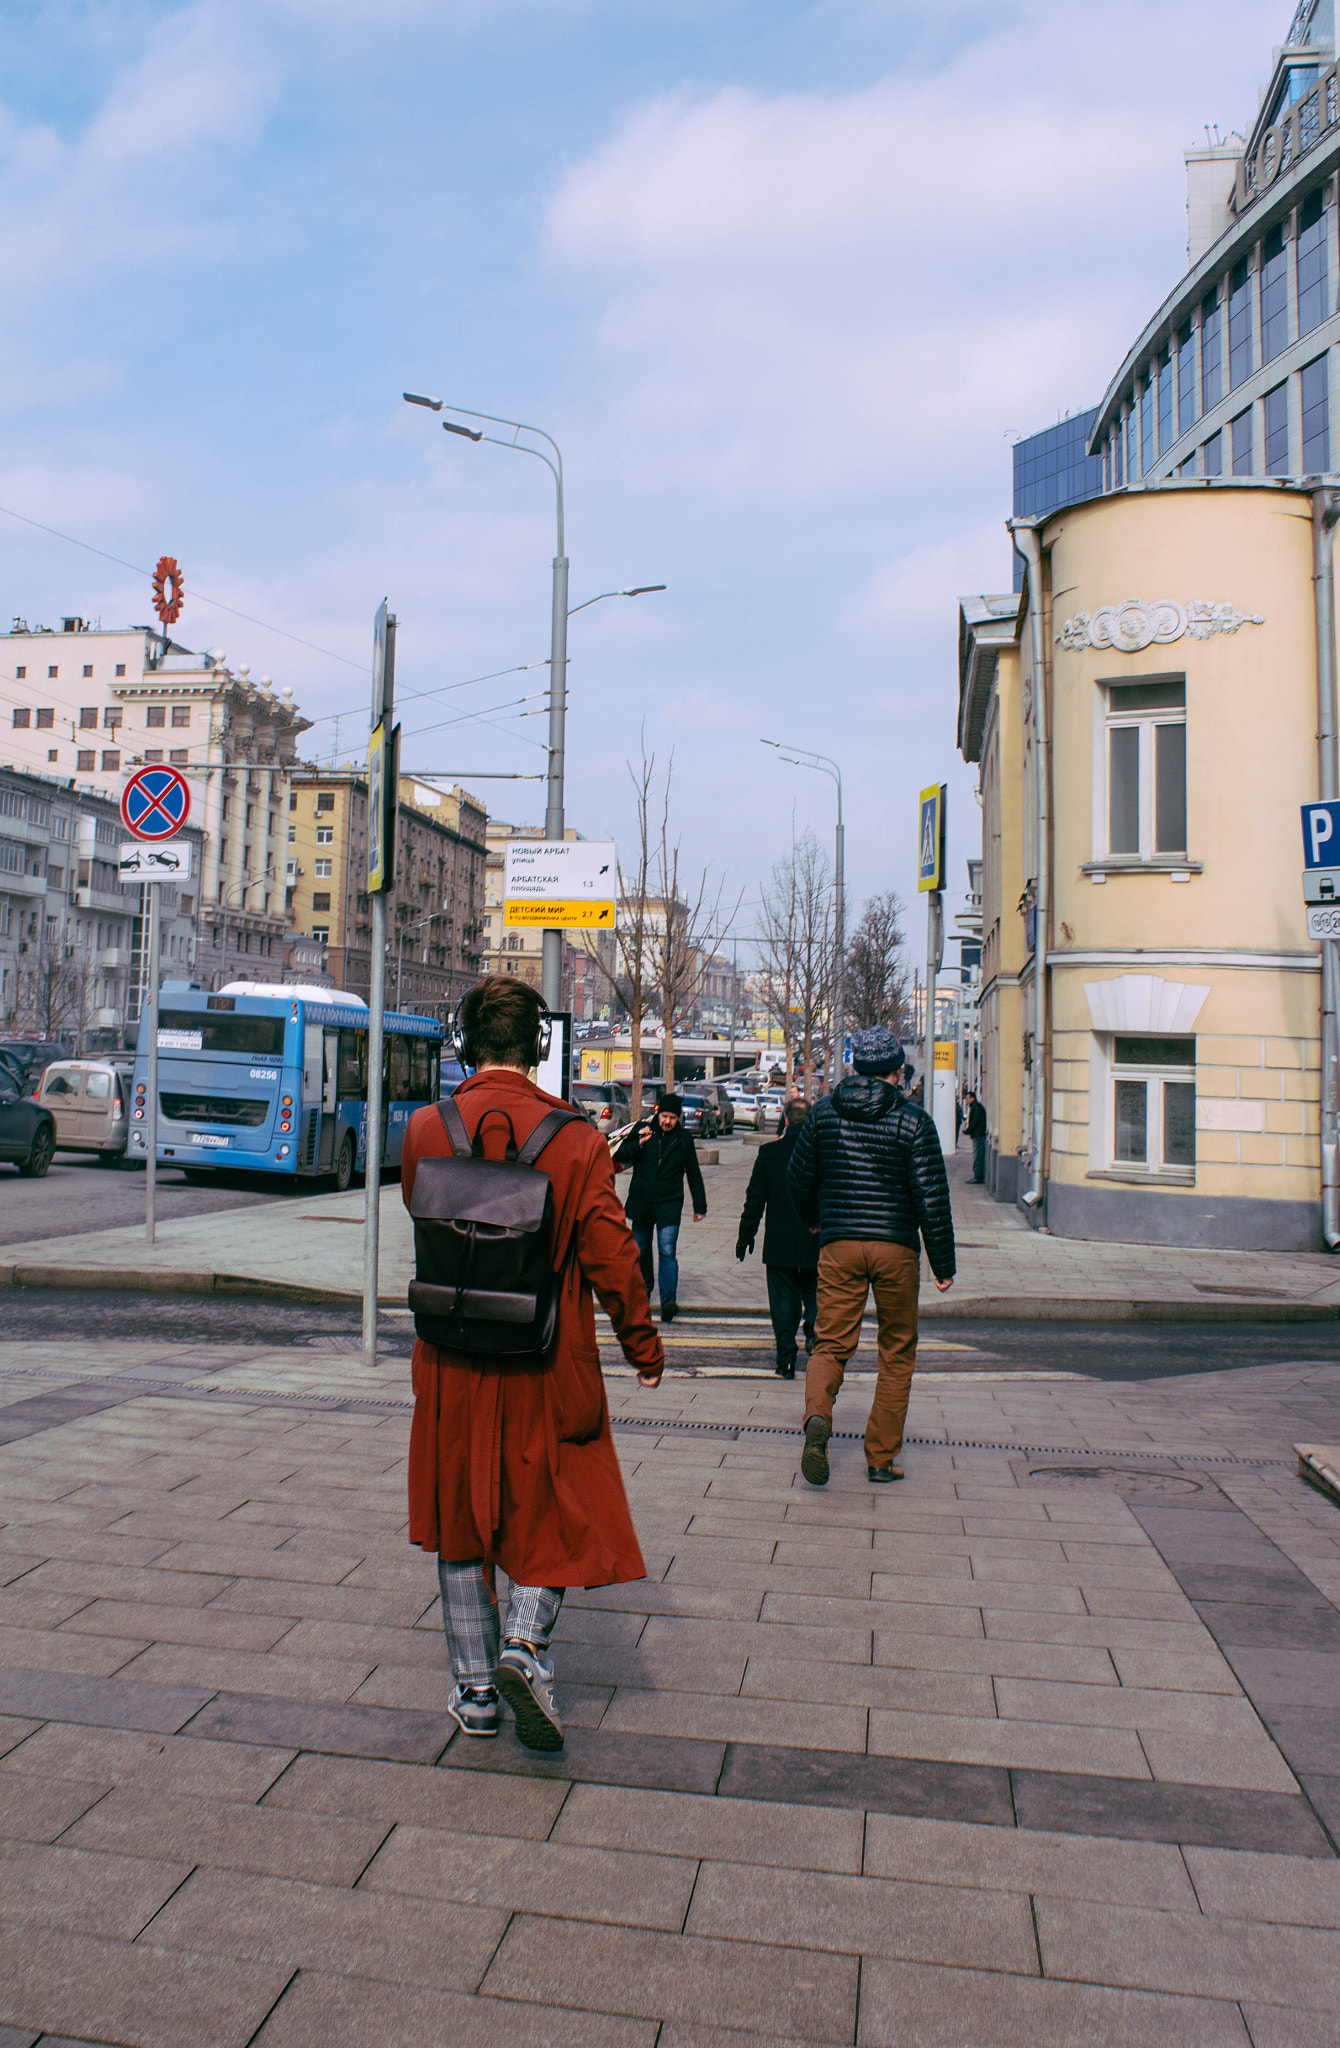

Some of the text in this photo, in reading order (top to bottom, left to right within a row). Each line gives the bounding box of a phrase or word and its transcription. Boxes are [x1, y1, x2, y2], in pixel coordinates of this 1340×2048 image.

[1310, 809, 1333, 863] P
[511, 847, 570, 855] НОВЫЙ АРБАТ
[511, 857, 535, 865] улица
[511, 875, 559, 883] АРБАТСКАЯ
[509, 906, 565, 914] ДЕТСКИЙ МИР
[249, 1068, 278, 1081] 08256
